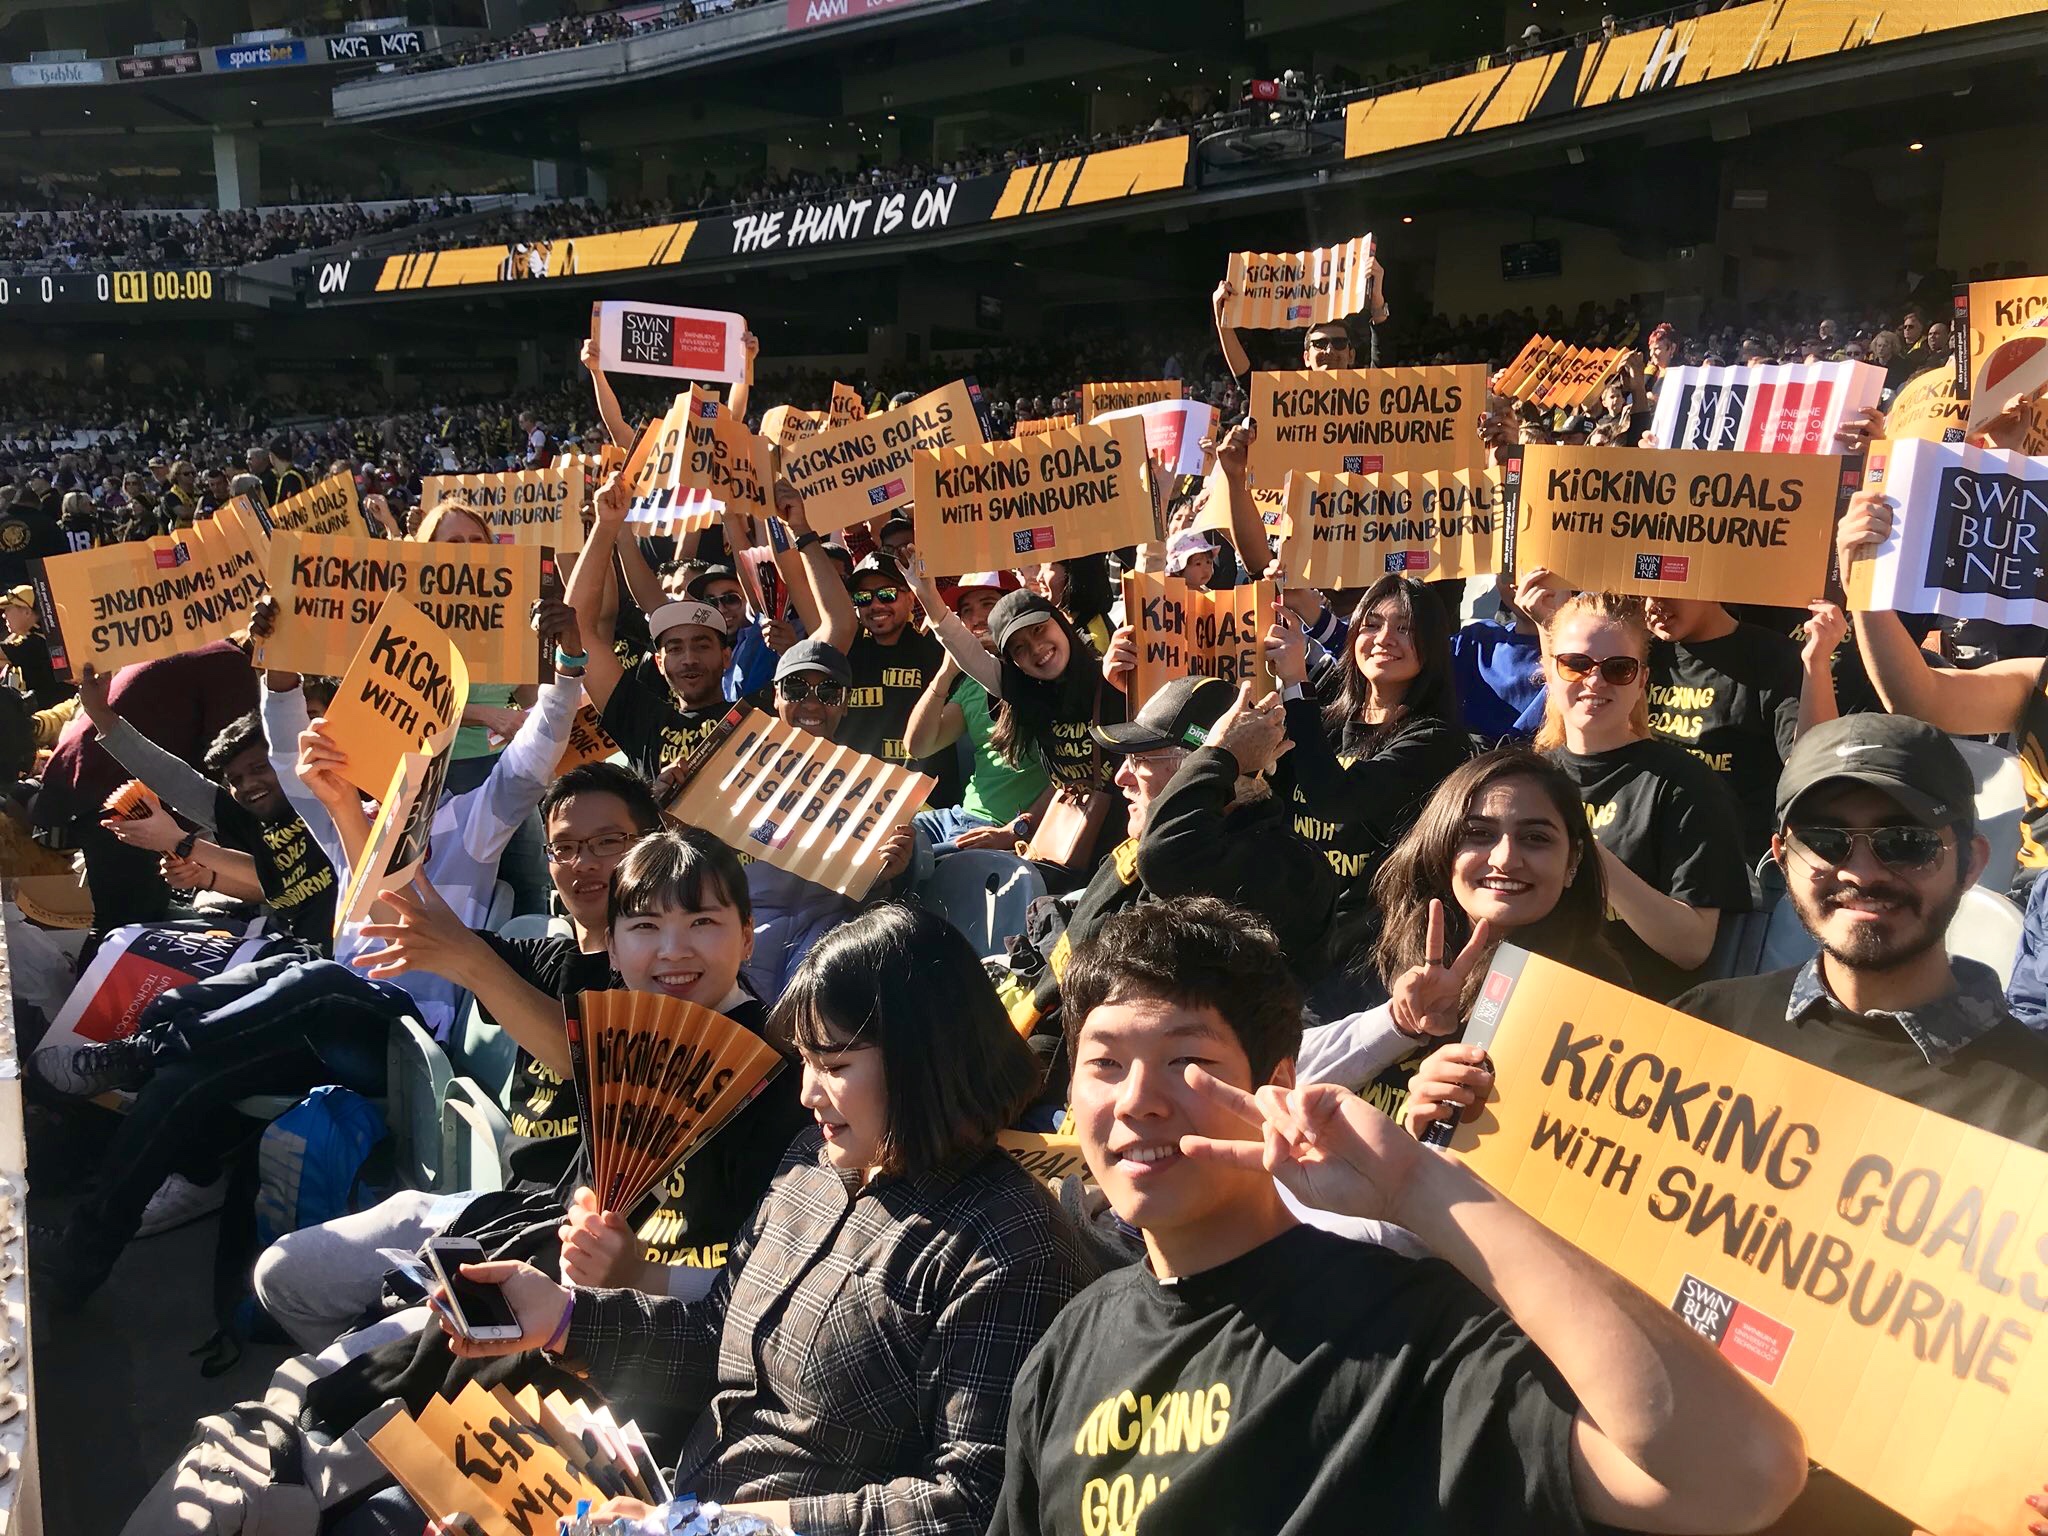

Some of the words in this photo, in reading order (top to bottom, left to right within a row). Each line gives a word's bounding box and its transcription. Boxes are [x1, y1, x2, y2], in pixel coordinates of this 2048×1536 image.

[230, 45, 292, 68] sportsbet
[732, 214, 785, 254] THE
[787, 199, 871, 247] HUNT
[872, 192, 907, 236] IS
[910, 183, 957, 231] ON
[41, 275, 53, 303] 0
[97, 273, 109, 301] 0
[118, 272, 143, 300] Q1
[153, 271, 212, 299] 00:00
[318, 259, 350, 293] ON
[626, 314, 670, 333] SWIN
[631, 330, 664, 347] BUR
[635, 345, 660, 361] NE
[1272, 388, 1370, 418] KiCKiNG
[1379, 385, 1462, 414] GOALS
[785, 434, 876, 483] KiCKiNG
[883, 402, 953, 449] GOALS
[1276, 423, 1317, 443] WiTH
[1323, 418, 1455, 445] SWiNBURNE
[935, 460, 1030, 498] KiCKiNG
[1040, 440, 1122, 483] GOALS
[312, 488, 347, 518] GOALS
[514, 481, 568, 504] GOALS
[942, 504, 983, 524] WiTH
[988, 475, 1120, 522] SWiNBURNE
[1310, 489, 1411, 517] KiCKiNG
[1422, 482, 1505, 513] GOALS
[1547, 467, 1676, 504] KiCKiNG
[1688, 474, 1804, 512] GOALS
[484, 504, 563, 526] WiNBURNE
[1552, 511, 1602, 534] WiTH
[1610, 511, 1789, 547] SWiNBURNE
[66, 531, 91, 552] 18
[1313, 523, 1356, 542] WiTH
[1958, 514, 2039, 554] BUR
[292, 554, 407, 593] KiCKiNG
[420, 563, 512, 598] GOALS
[864, 556, 880, 570] LA
[1963, 552, 2021, 589] NE
[90, 567, 216, 620] SWiNBURNE
[294, 596, 343, 620] WiTH
[92, 610, 173, 652] GOALS
[360, 678, 419, 735] WiTH
[1648, 683, 1715, 709] KICKING
[1648, 712, 1704, 738] GOALS
[1294, 813, 1335, 841] WITH
[1541, 1022, 1820, 1190] KiCKiNG
[1530, 1109, 1642, 1195] WiTH
[1647, 1165, 2032, 1396] SWiNBURNE
[1682, 1298, 1719, 1330] BUR
[1075, 1381, 1231, 1457] KICKING
